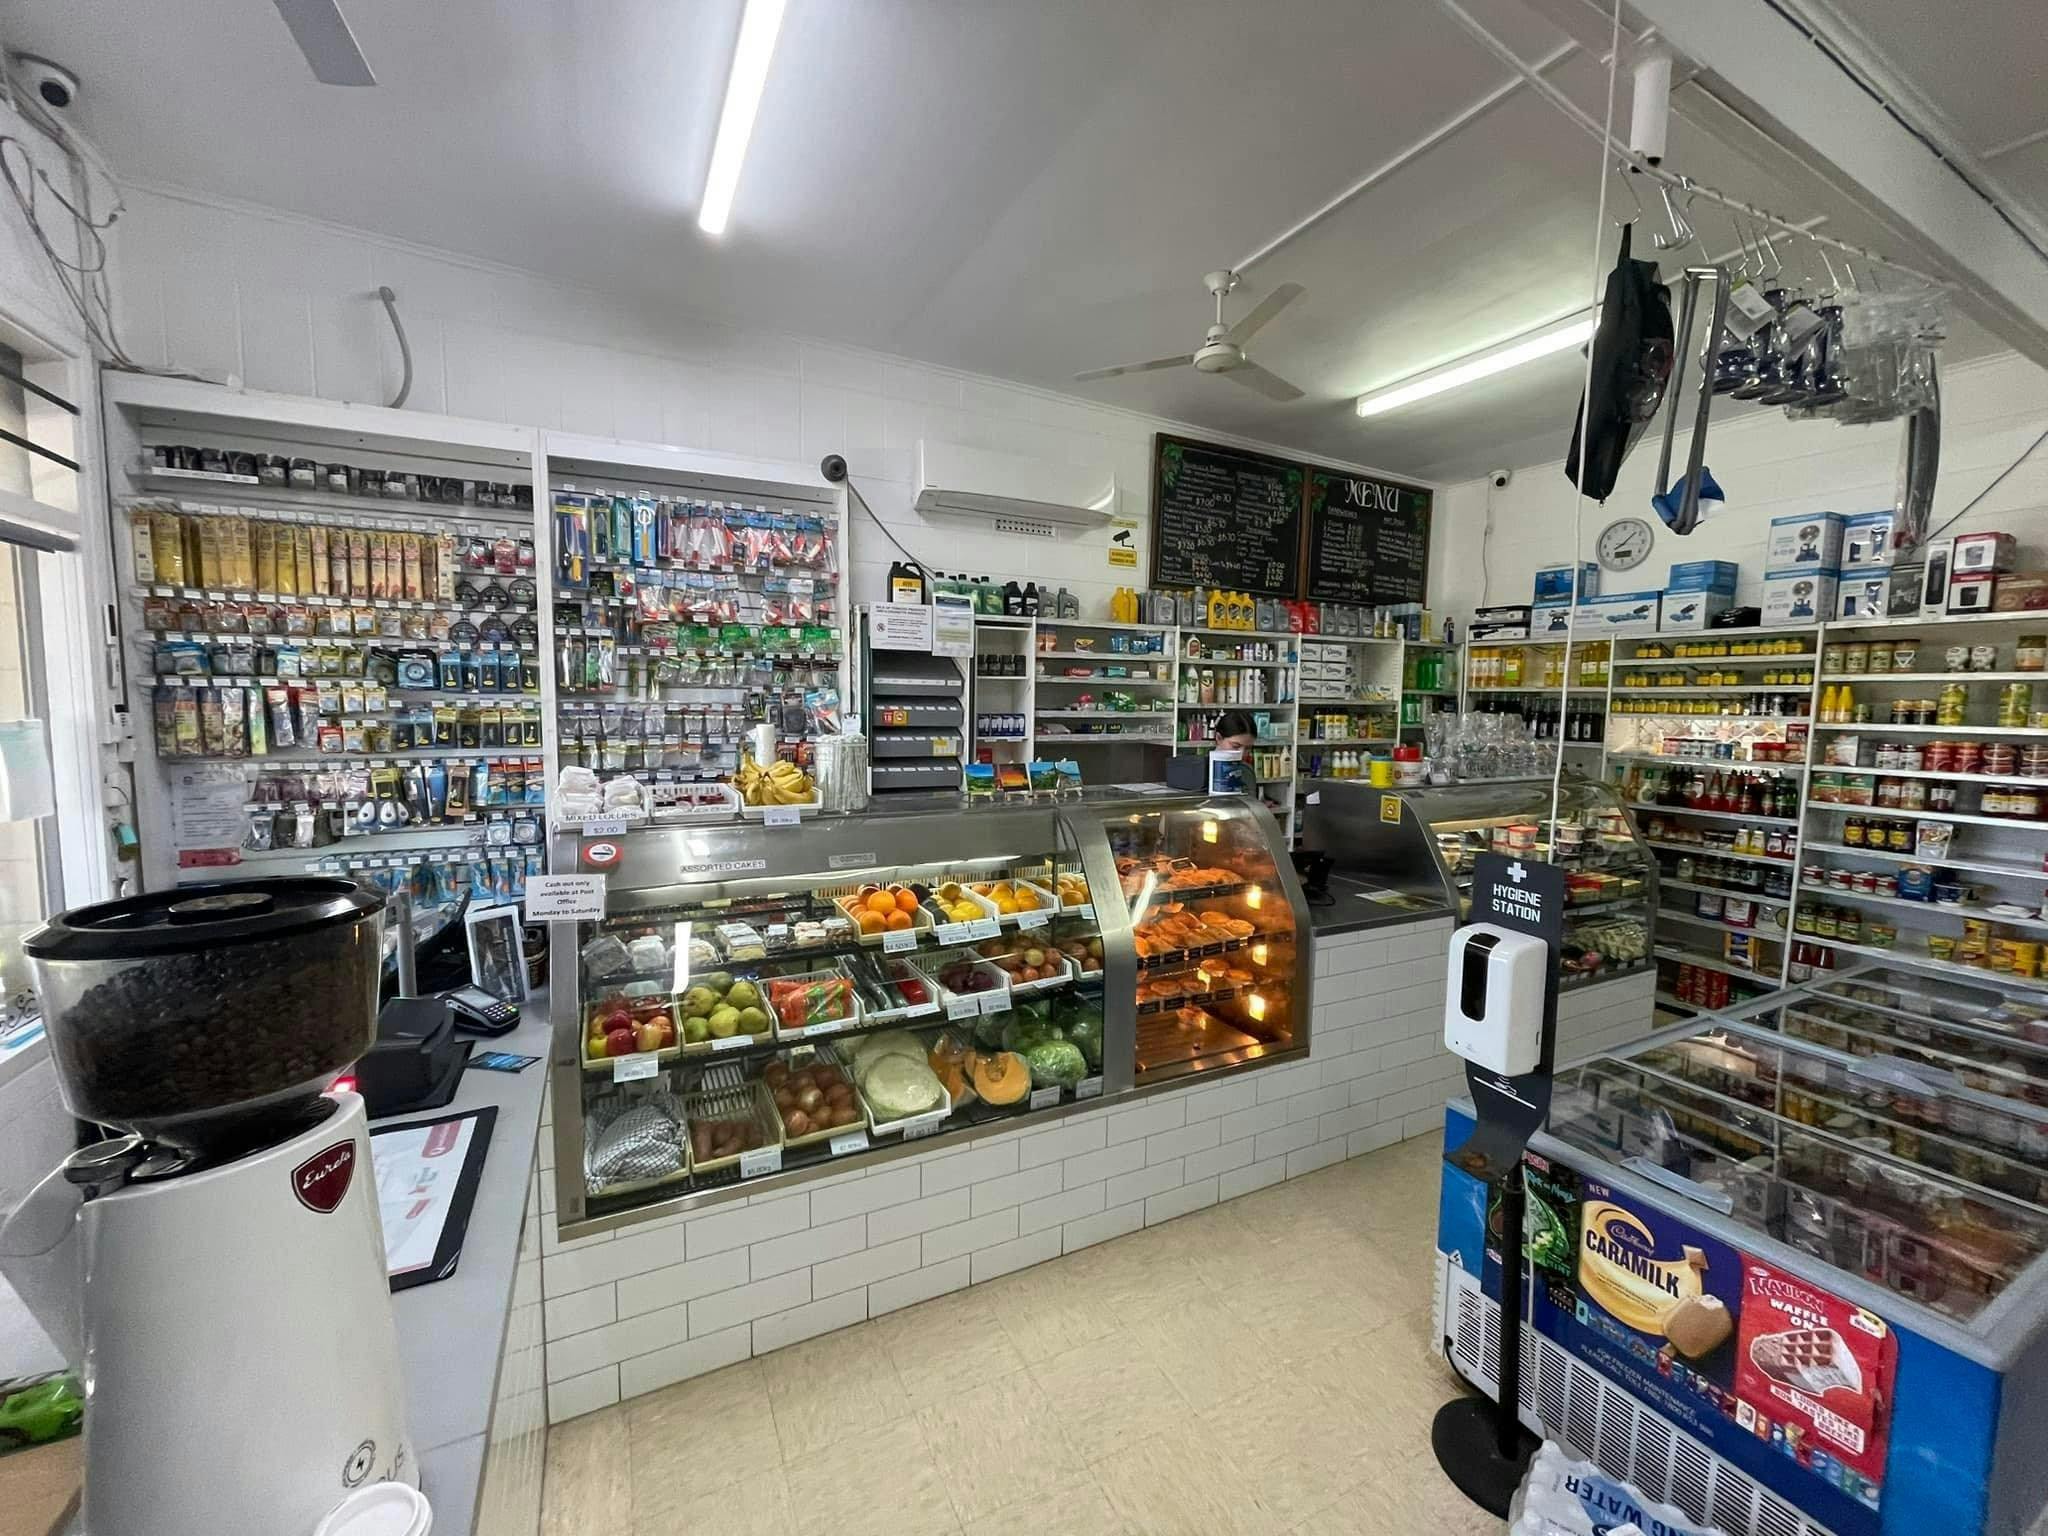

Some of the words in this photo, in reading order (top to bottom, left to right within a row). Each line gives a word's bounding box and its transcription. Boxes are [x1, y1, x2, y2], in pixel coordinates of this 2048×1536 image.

[1345, 479, 1400, 512] MENU
[565, 814, 596, 822] MIXED
[593, 826, 618, 834] $2.00
[680, 863, 732, 873] ASSORTED
[733, 861, 764, 870] CAKES
[1493, 883, 1542, 908] HYGIENE
[1492, 899, 1541, 923] STATION
[1589, 1184, 1610, 1197] NEW
[1610, 1225, 1655, 1256] Cadbury
[1586, 1229, 1680, 1298] CARAMILK
[1749, 1277, 1825, 1313] MAXIBON
[1769, 1299, 1830, 1327] WAFFLE
[1789, 1316, 1815, 1331] ON
[1794, 1392, 1825, 1414] LOOKS
[1565, 1474, 1642, 1529] WATER
